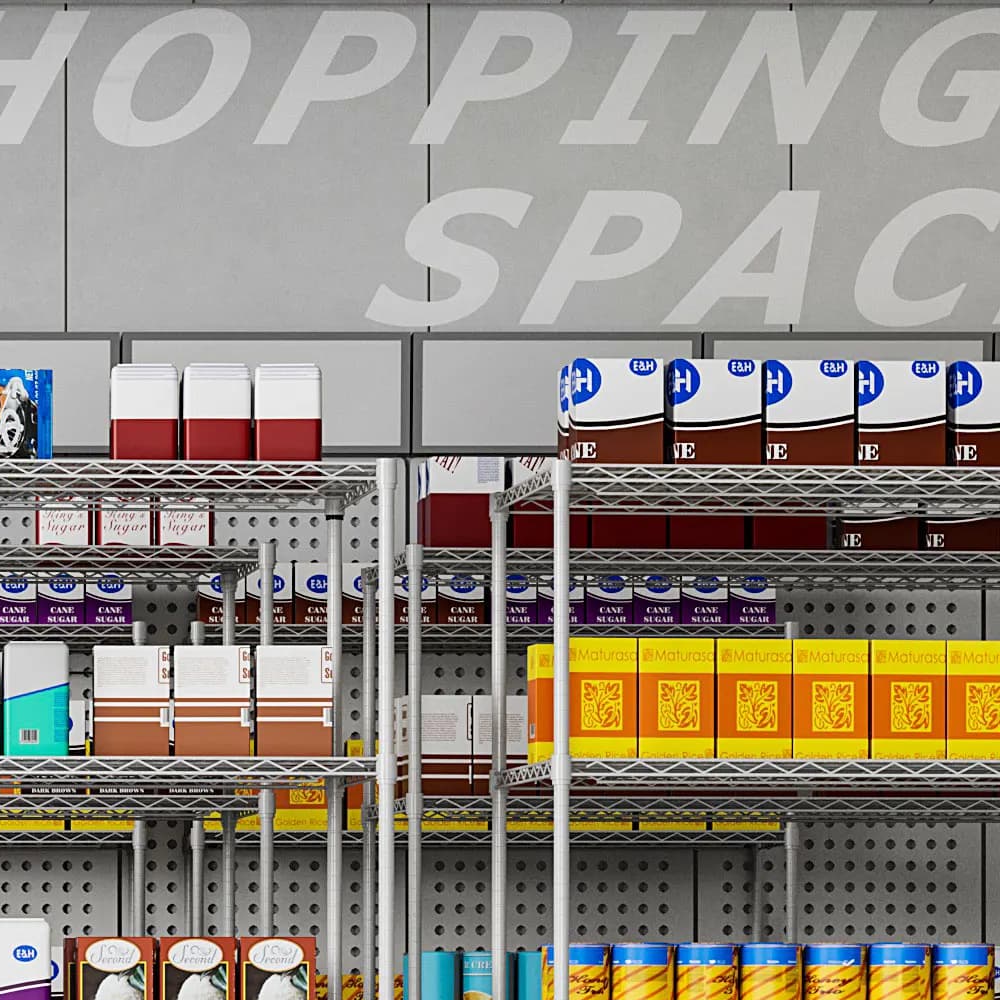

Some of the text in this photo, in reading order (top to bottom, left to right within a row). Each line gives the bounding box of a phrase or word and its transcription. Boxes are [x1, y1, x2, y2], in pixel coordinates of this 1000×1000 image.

[364, 187, 1000, 327] SPAC
[633, 361, 654, 371] E&H
[731, 361, 752, 372] E&H
[824, 362, 845, 373] E&H
[915, 363, 937, 374] E&H
[42, 521, 85, 536] Sugar
[104, 521, 147, 536] Sugar
[162, 521, 206, 536] Sugar
[98, 606, 123, 614] CANE
[451, 606, 475, 614] CANE
[599, 606, 623, 614] CANE
[742, 606, 766, 614] CANE
[95, 616, 126, 624] SUGAR
[448, 616, 478, 624] SUGAR
[596, 616, 626, 624] SUGAR
[739, 616, 769, 624] SUGAR
[276, 818, 307, 827] Golden
[16, 948, 35, 959] E&H
[90, 943, 134, 965] Second
[172, 943, 216, 965] Second
[253, 943, 297, 965] Second
